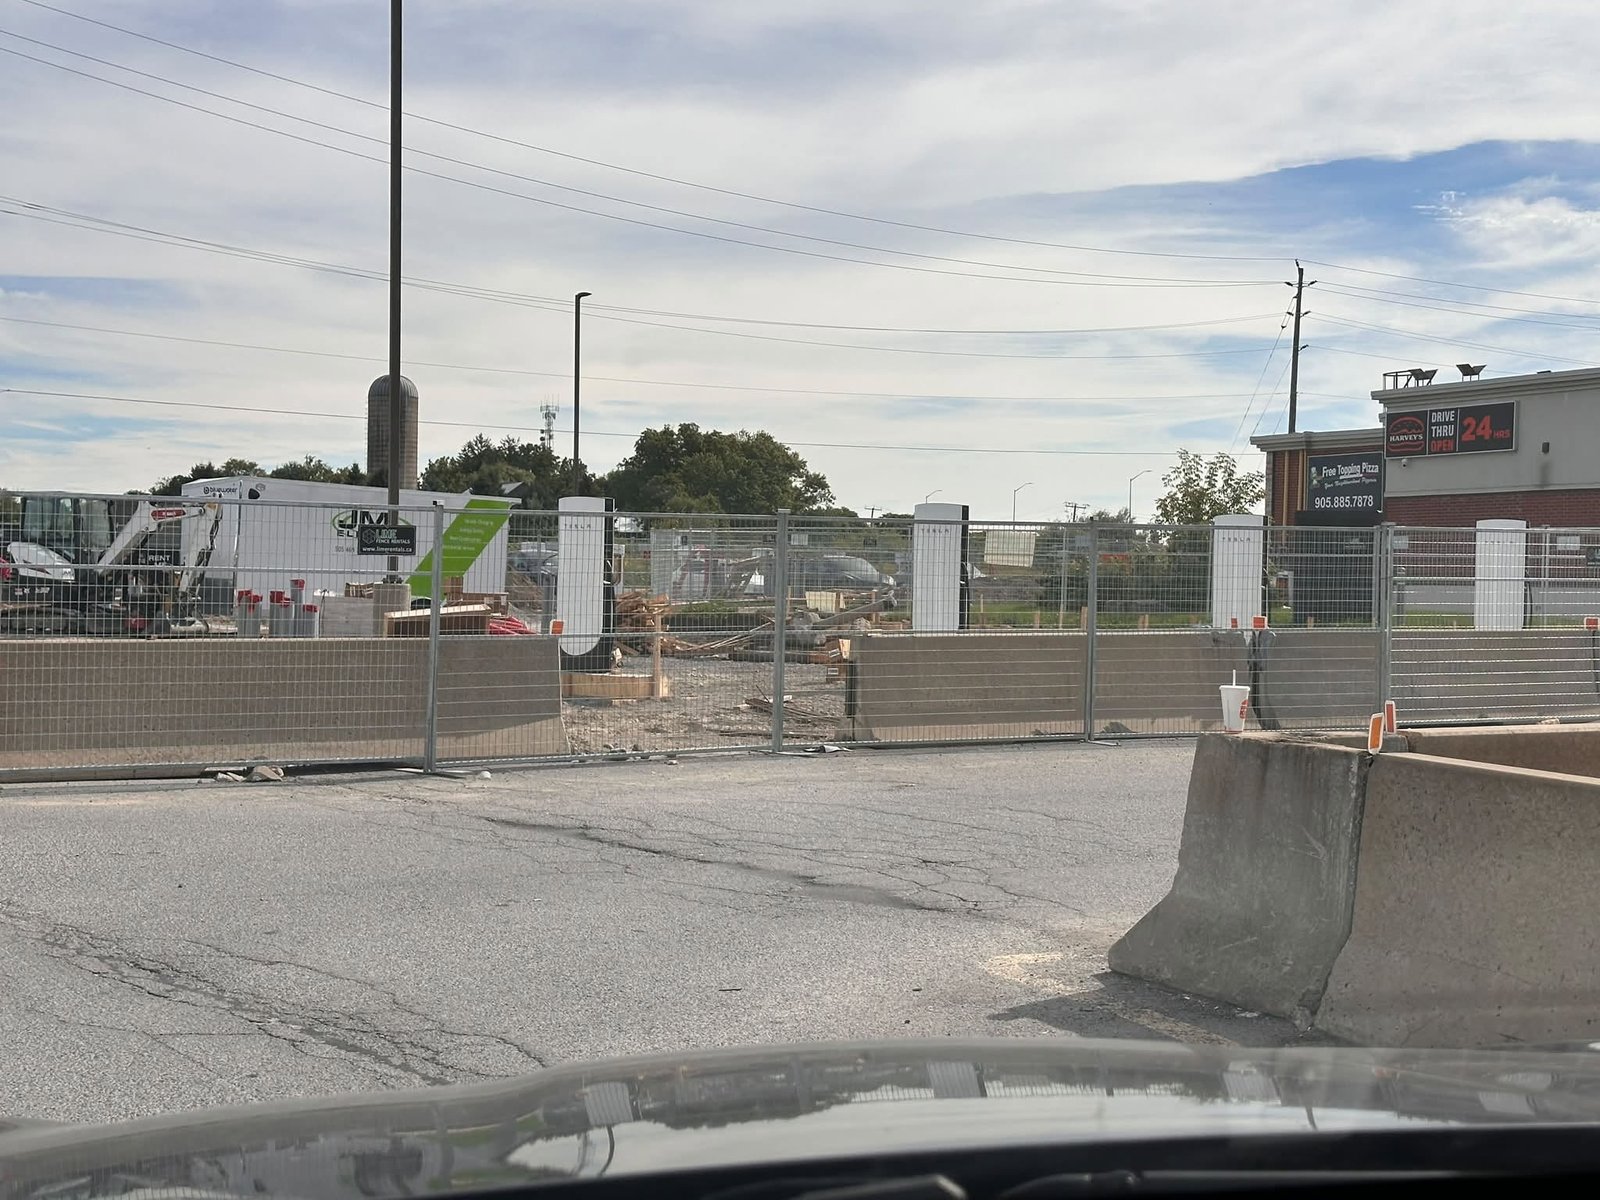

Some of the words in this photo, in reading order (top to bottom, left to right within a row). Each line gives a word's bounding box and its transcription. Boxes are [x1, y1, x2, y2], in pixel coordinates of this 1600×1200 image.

[1431, 410, 1455, 423] DRIVE
[1431, 425, 1455, 437] THRU
[1461, 415, 1492, 442] 24
[1493, 430, 1511, 439] HRS
[1389, 433, 1423, 442] HARVEY'S
[1431, 439, 1454, 452] OPEN
[1322, 466, 1337, 477] Free
[1337, 463, 1361, 476] Topping
[1361, 462, 1379, 473] Pizza
[1314, 495, 1374, 508] 905.885.7878
[375, 529, 397, 539] LIME
[148, 554, 171, 562] RENT
